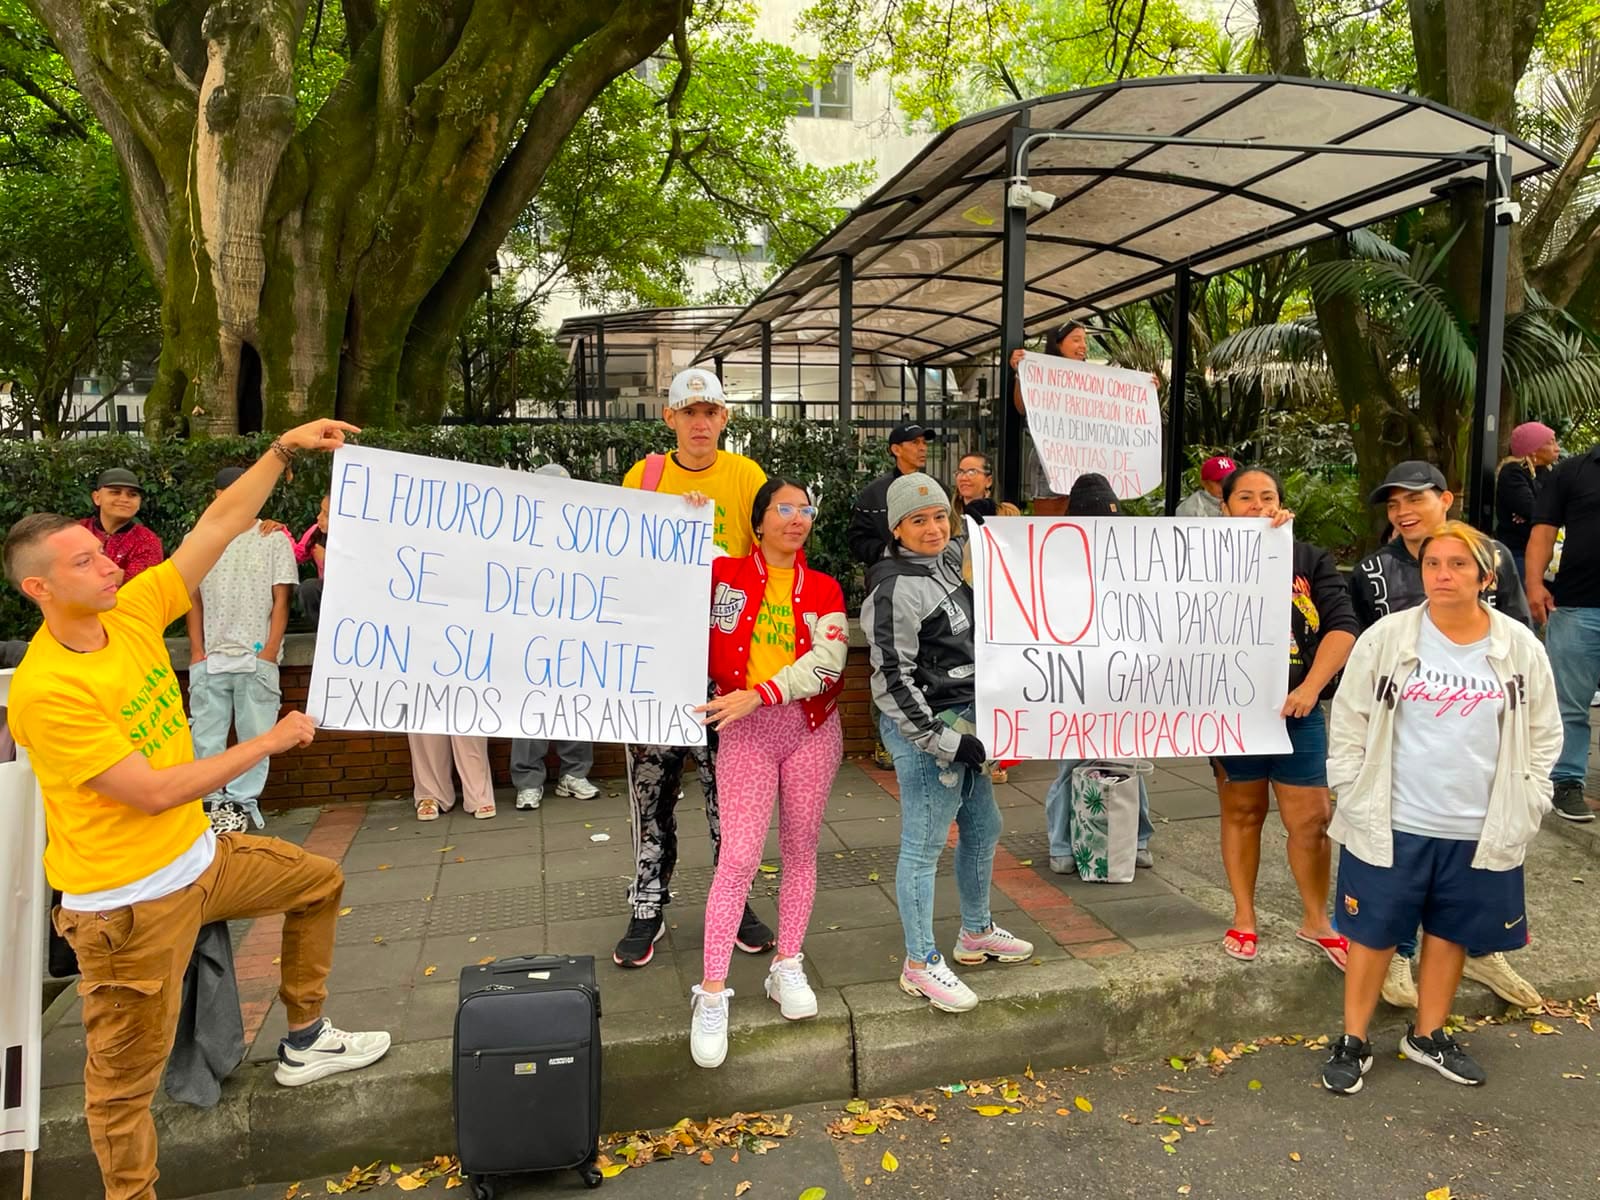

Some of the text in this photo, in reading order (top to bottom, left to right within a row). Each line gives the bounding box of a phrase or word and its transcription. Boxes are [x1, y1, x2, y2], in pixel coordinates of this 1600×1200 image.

[1026, 364, 1043, 384] SIN
[1107, 378, 1148, 405] COMPLETA
[1027, 388, 1041, 407] NO
[1042, 391, 1062, 412] HAY
[1125, 407, 1152, 425] REAL
[1042, 439, 1136, 471] GARANTIAS DE
[1043, 415, 1050, 436] A
[1052, 416, 1065, 439] LA
[1133, 426, 1159, 448] SIN
[338, 463, 380, 523] EL
[389, 474, 504, 540] FUTURO
[513, 494, 544, 548] DE
[557, 503, 629, 557] SOTO
[640, 513, 712, 567] NORTE
[389, 546, 623, 625] SE DECIDE
[983, 522, 1095, 645] NO
[1102, 526, 1126, 582] A
[1134, 526, 1167, 583] LA
[1101, 590, 1274, 646] CION PARCIAL
[333, 617, 655, 694] CON SU GENTE
[1023, 648, 1256, 707] SIN GARANTIAS
[319, 677, 704, 746] EXIGIMOS GARANTIAS
[993, 708, 1033, 759] DE
